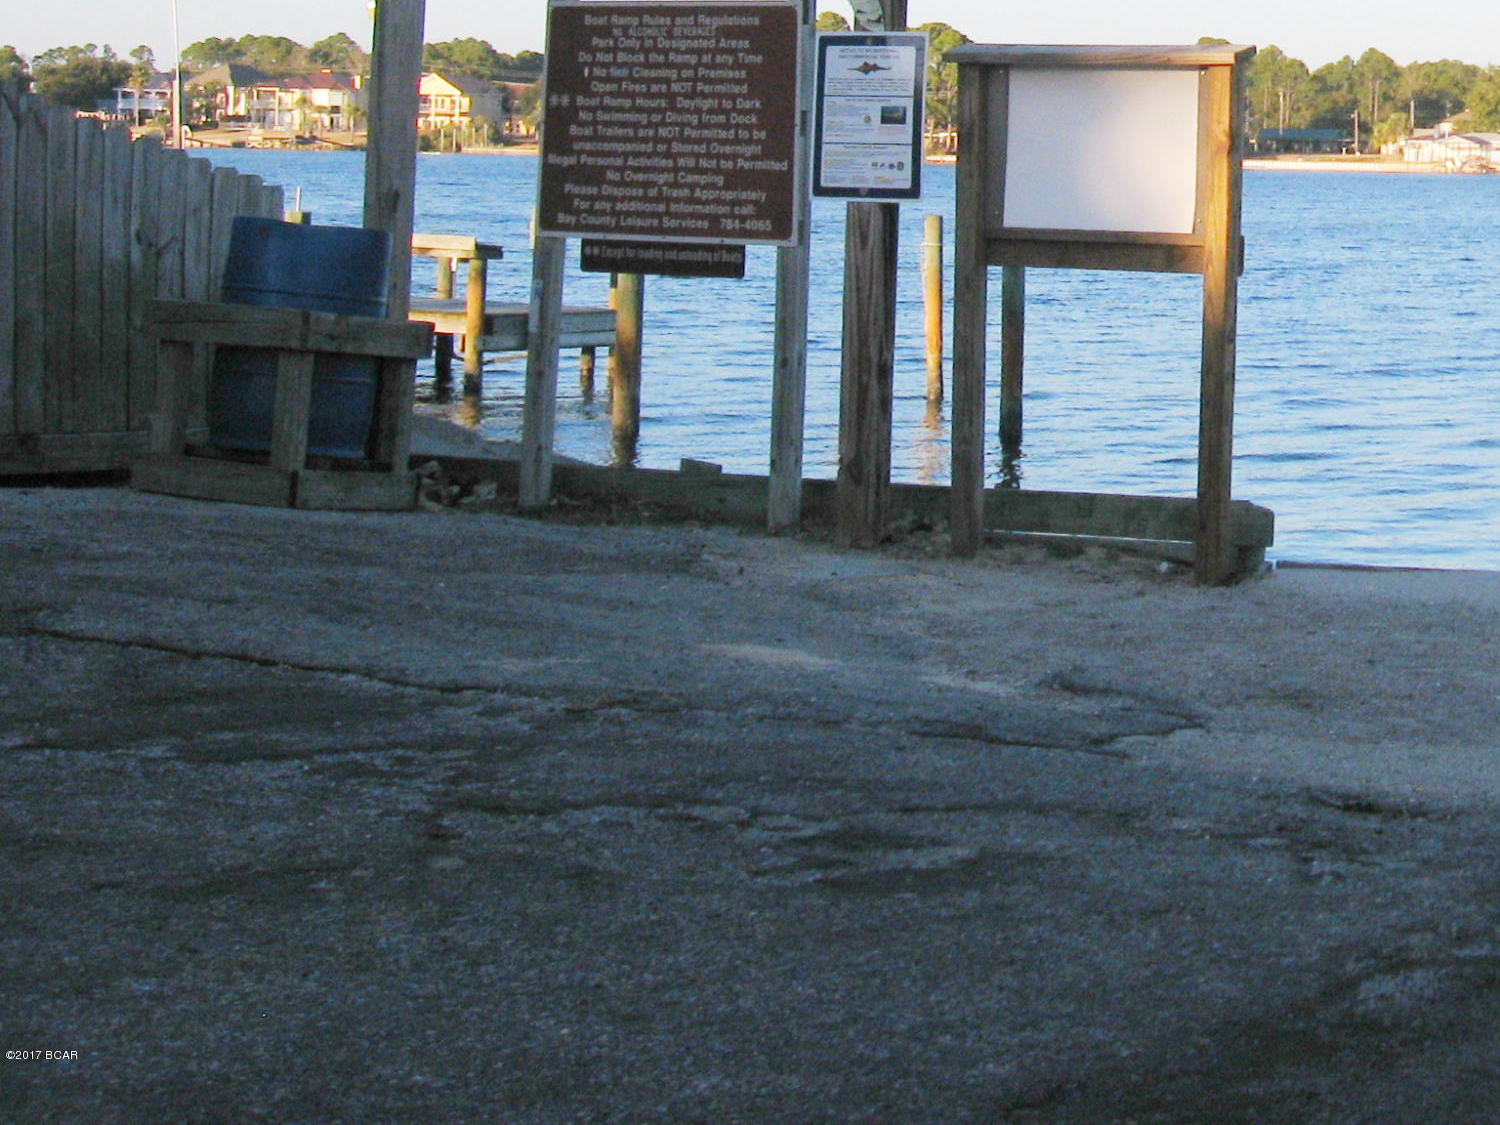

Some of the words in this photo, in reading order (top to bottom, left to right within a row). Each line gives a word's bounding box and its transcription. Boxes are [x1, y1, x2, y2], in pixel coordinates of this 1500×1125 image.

[585, 15, 608, 26] Boat
[611, 15, 639, 27] Ramp
[643, 15, 670, 26] Rules
[675, 16, 694, 26] and
[698, 16, 759, 27] Regulations
[592, 38, 613, 48] Park
[618, 38, 640, 49] Only
[645, 38, 653, 48] in
[658, 38, 715, 50] Designated
[719, 38, 749, 48] Areas
[579, 52, 592, 62] Do
[596, 52, 613, 62] Not
[617, 52, 644, 63] Block
[649, 53, 664, 63] the
[669, 53, 697, 65] Ramp
[702, 53, 711, 63] at
[716, 55, 733, 65] any
[738, 54, 763, 63] Time
[593, 67, 606, 77] No
[633, 68, 677, 80] Cleaning
[681, 70, 694, 78] on
[698, 68, 746, 78] Premises
[591, 82, 617, 94] Open
[622, 82, 646, 93] Fires
[651, 84, 667, 93] are
[671, 83, 693, 93] NOT
[697, 83, 747, 94] Permitted
[577, 97, 599, 107] Boat
[603, 97, 632, 109] Ramp
[677, 98, 718, 109] Daylight
[722, 99, 732, 108] to
[736, 98, 761, 109] Dark
[579, 112, 592, 121] No
[596, 112, 646, 125] Swimming
[651, 114, 661, 123] or
[666, 113, 698, 125] Diving
[702, 113, 726, 123] from
[731, 113, 757, 124] Dock
[569, 126, 593, 136] Boat
[598, 126, 633, 137] Trailers
[638, 128, 654, 137] are
[658, 127, 679, 137] NOT
[684, 128, 734, 139] Permitted
[738, 130, 748, 139] to
[753, 130, 765, 140] be
[573, 141, 653, 154] unaccompanied
[657, 144, 667, 153] or
[672, 143, 706, 154] Stored
[710, 143, 761, 156] Overnight
[580, 155, 623, 166] Personal
[627, 156, 673, 167] Activities
[677, 157, 695, 168] Will
[699, 158, 716, 168] Not
[720, 159, 733, 169] be
[737, 159, 787, 170] Permitted
[607, 171, 620, 181] No
[624, 171, 673, 184] Overnight
[678, 173, 724, 186] Camping
[565, 185, 597, 195] Please
[602, 186, 643, 198] Dispose
[648, 187, 658, 197] of
[662, 187, 690, 198] Trash
[694, 189, 766, 202] Appropriately
[574, 199, 589, 209] For
[593, 201, 612, 212] any
[616, 200, 665, 211] additional
[557, 213, 576, 226] Bay
[580, 214, 616, 227] County
[620, 215, 657, 227] Leisure
[663, 217, 708, 229] Services
[720, 218, 772, 231] 784-4065
